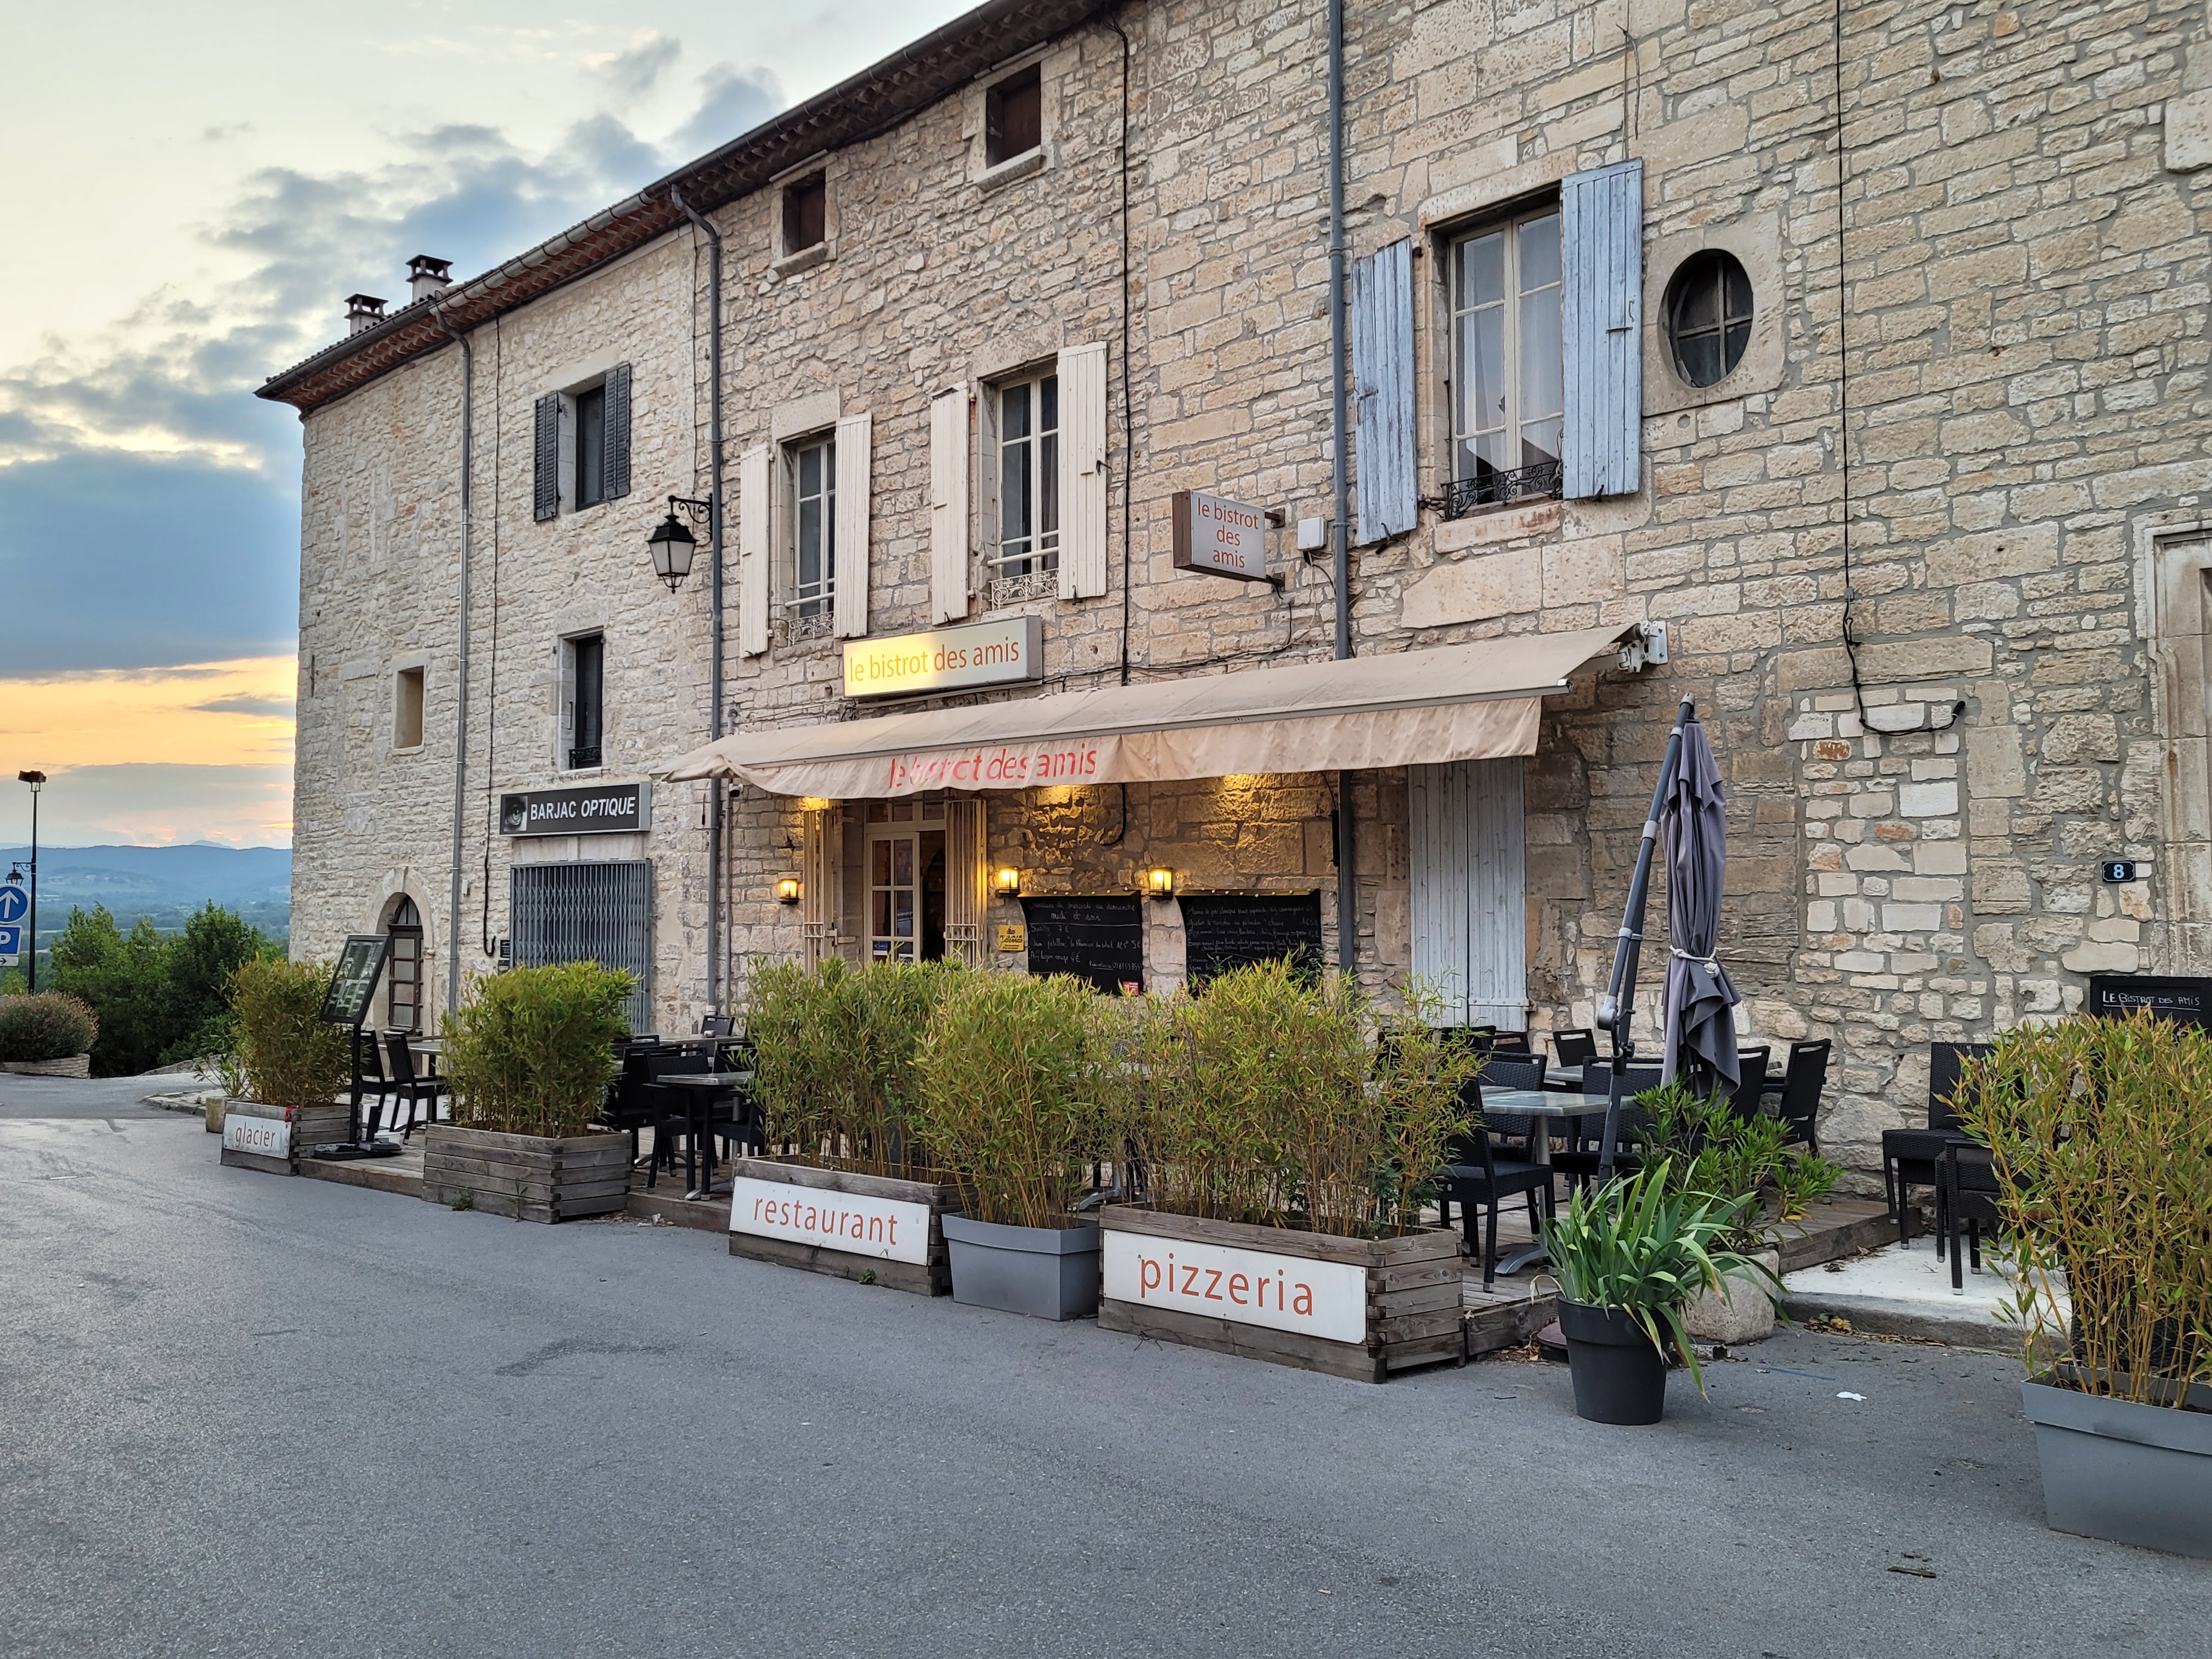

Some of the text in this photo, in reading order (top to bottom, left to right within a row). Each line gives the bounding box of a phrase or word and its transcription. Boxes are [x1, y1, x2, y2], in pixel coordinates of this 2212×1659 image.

[1198, 498, 1259, 529] le bistrot
[1216, 525, 1240, 546] des
[1213, 550, 1245, 568] amis
[850, 636, 1019, 682] le bistrot des amis
[988, 748, 1029, 780] des
[1036, 743, 1097, 777] amis
[530, 797, 636, 820] BARJAC OPTIQUE
[2113, 864, 2124, 879] 8
[1051, 910, 1101, 921] midi et soir
[2103, 990, 2117, 1003] LE
[235, 1122, 275, 1148] glacier
[754, 1198, 898, 1246] restaurant
[1141, 1252, 1313, 1316] pizzeria
